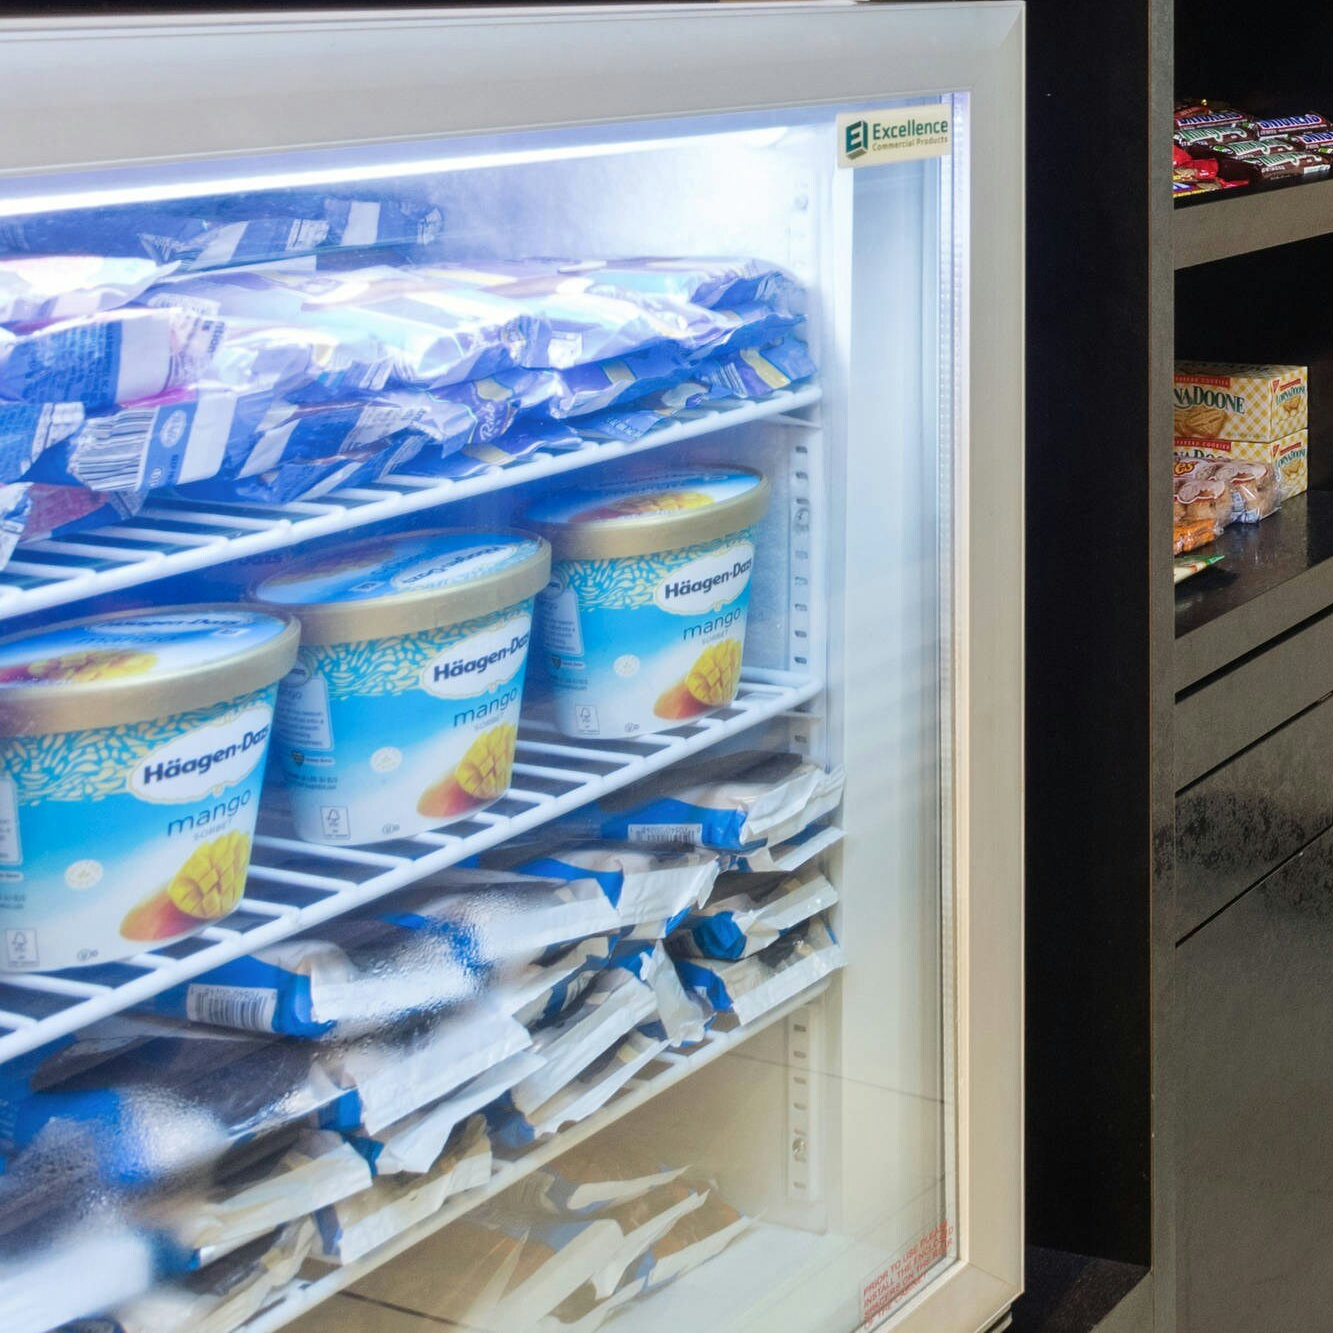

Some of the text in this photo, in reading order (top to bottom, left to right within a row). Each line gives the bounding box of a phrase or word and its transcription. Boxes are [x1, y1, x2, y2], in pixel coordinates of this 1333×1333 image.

[872, 119, 949, 141] Excellence
[872, 136, 949, 152] Commercial Products
[683, 606, 741, 641] mango
[453, 686, 519, 729] mango
[143, 724, 270, 786] Häagen-Dazs
[167, 788, 251, 838] mango
